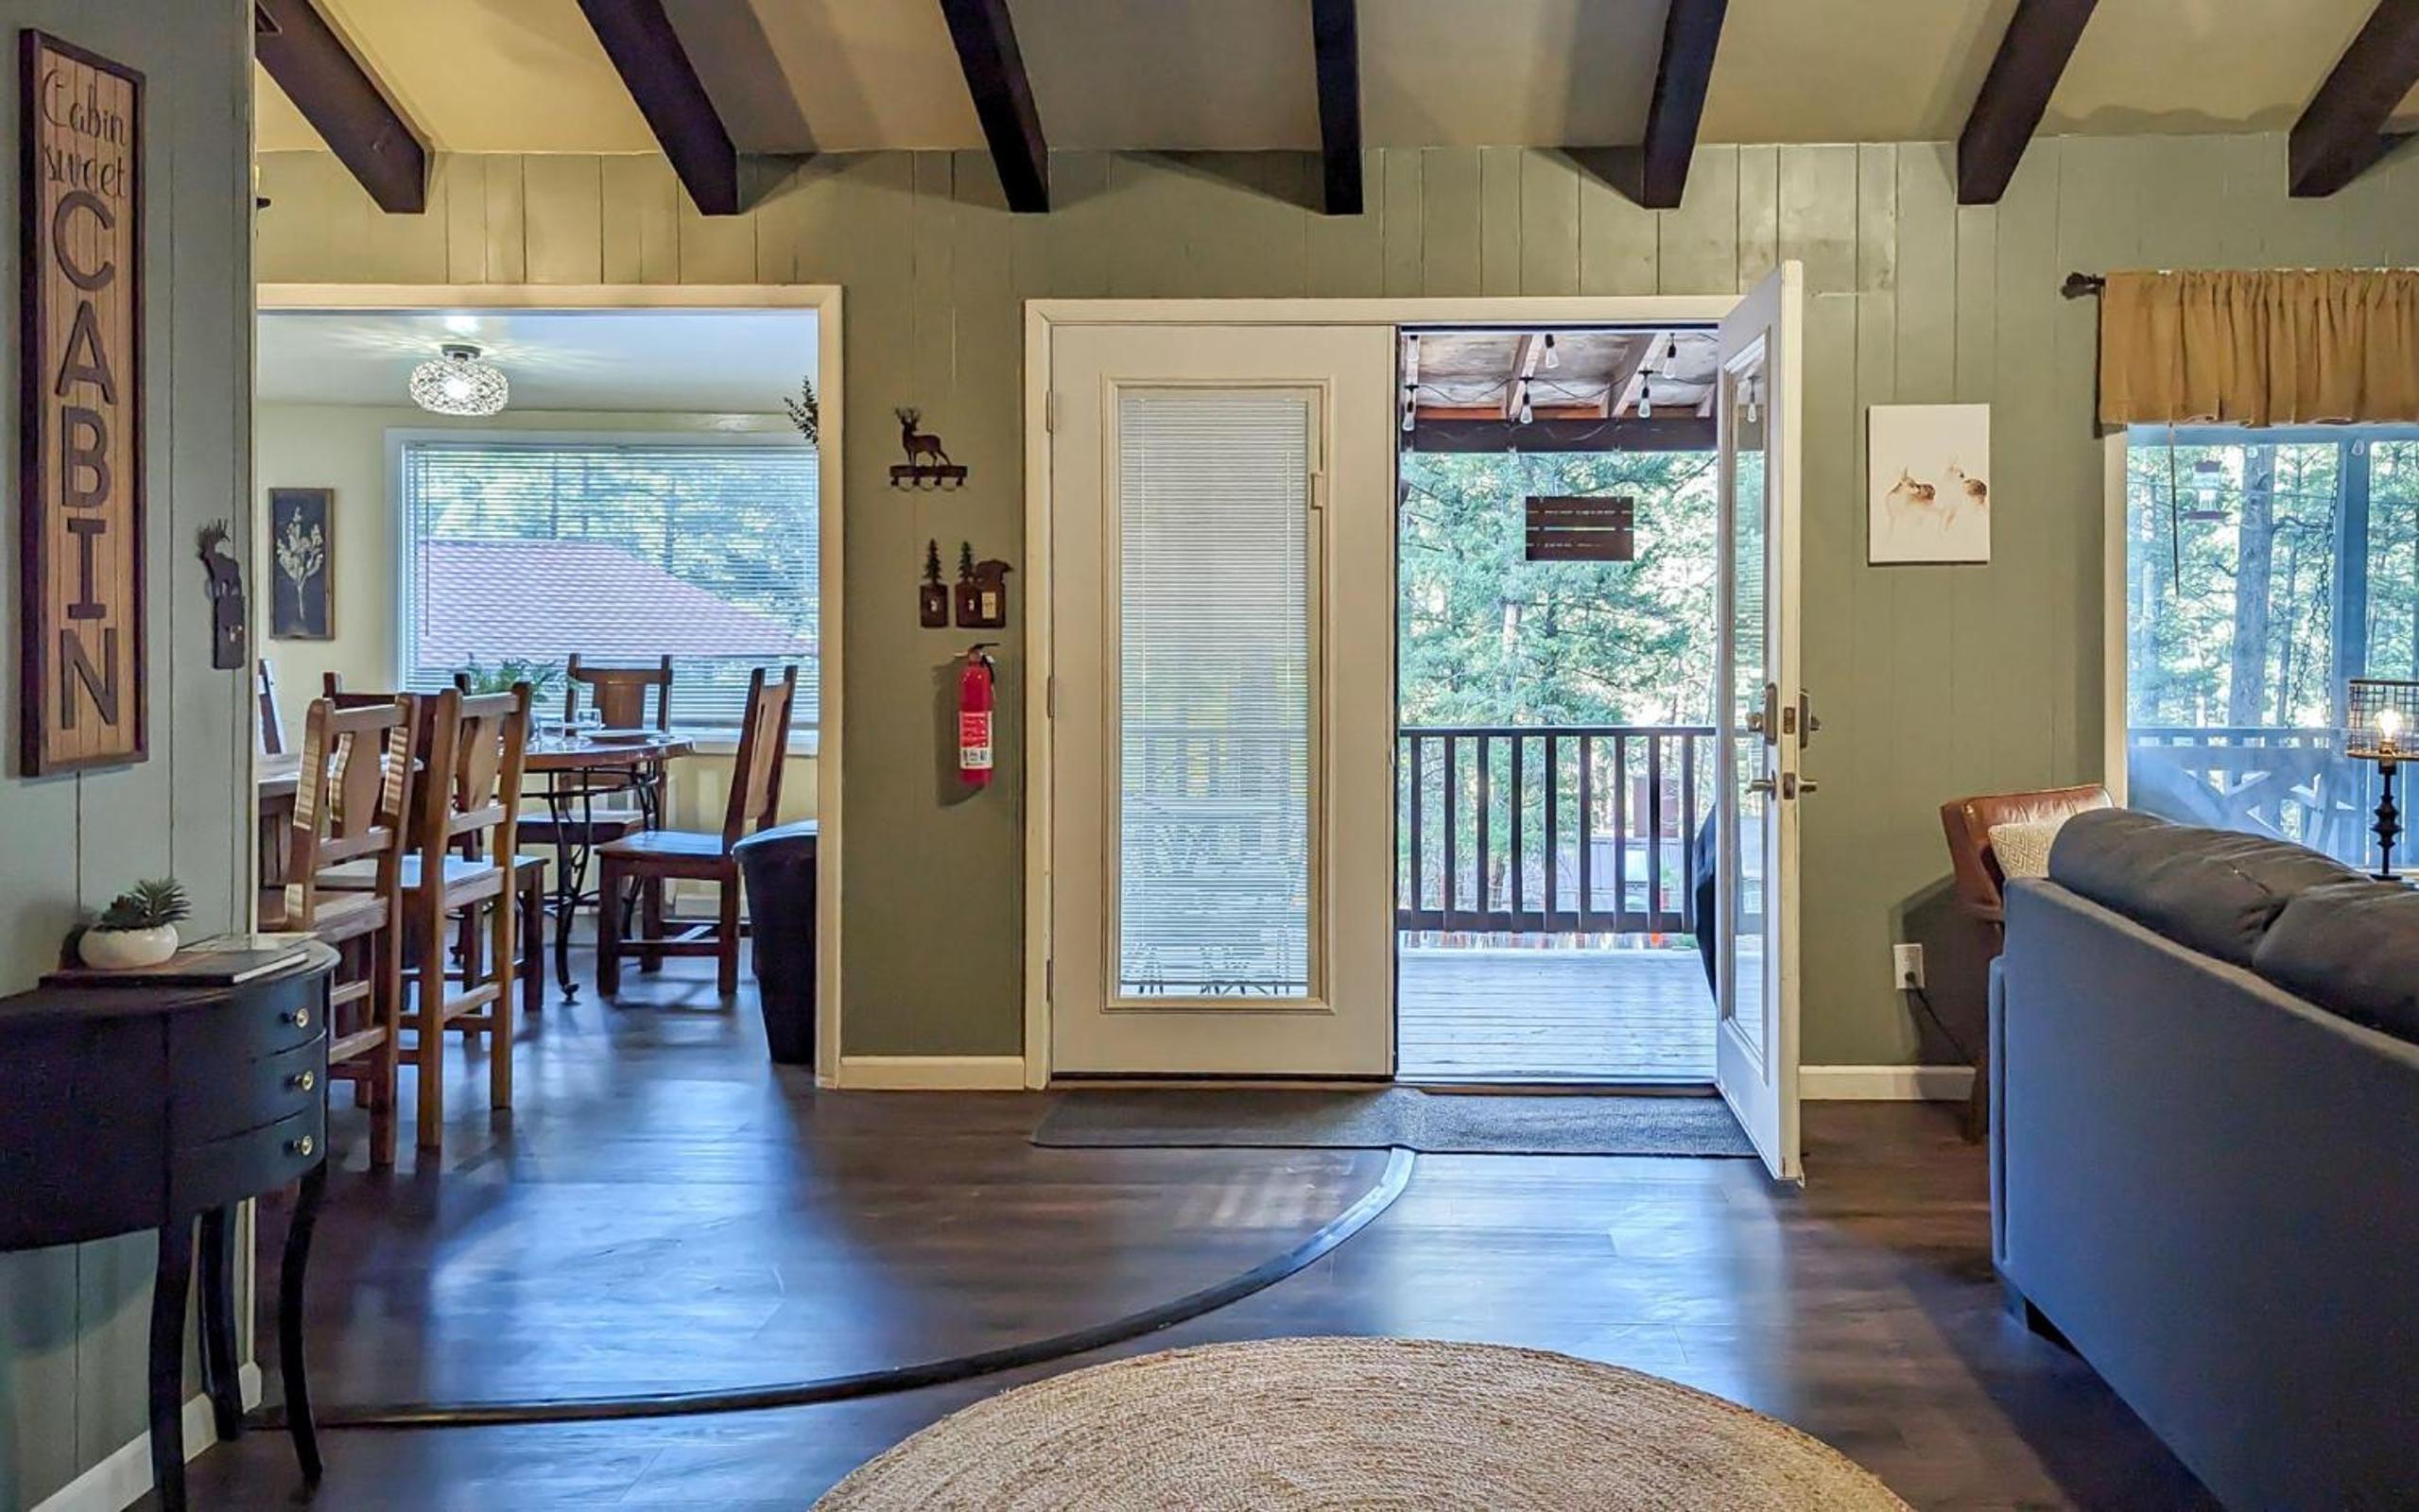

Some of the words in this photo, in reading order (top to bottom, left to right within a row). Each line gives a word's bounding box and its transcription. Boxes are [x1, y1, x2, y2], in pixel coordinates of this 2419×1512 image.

[43, 69, 128, 146] Cabin
[43, 142, 126, 198] sweet
[53, 191, 118, 730] CABIN
